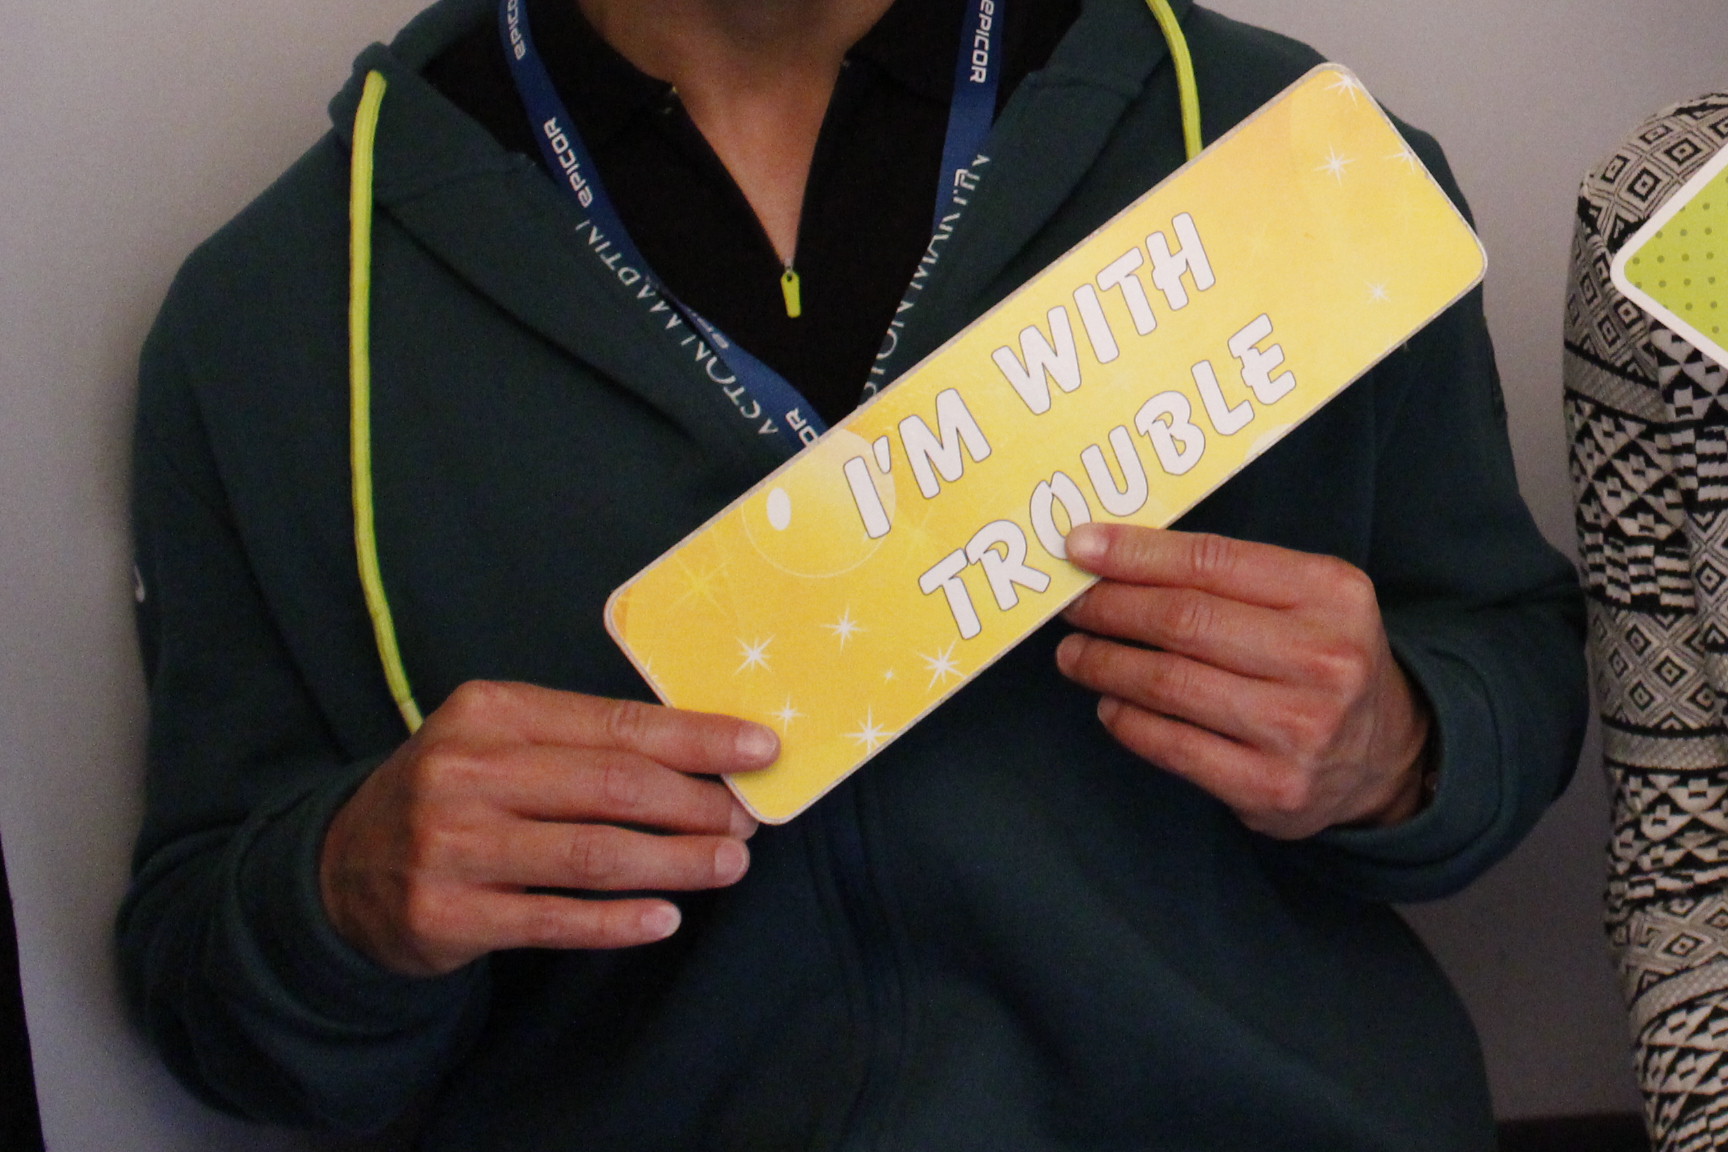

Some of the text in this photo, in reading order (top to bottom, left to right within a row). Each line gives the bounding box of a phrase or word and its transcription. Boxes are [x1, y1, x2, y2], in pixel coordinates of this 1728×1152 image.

[842, 210, 1217, 540] I'M WITH
[917, 312, 1297, 641] TROUBLE
